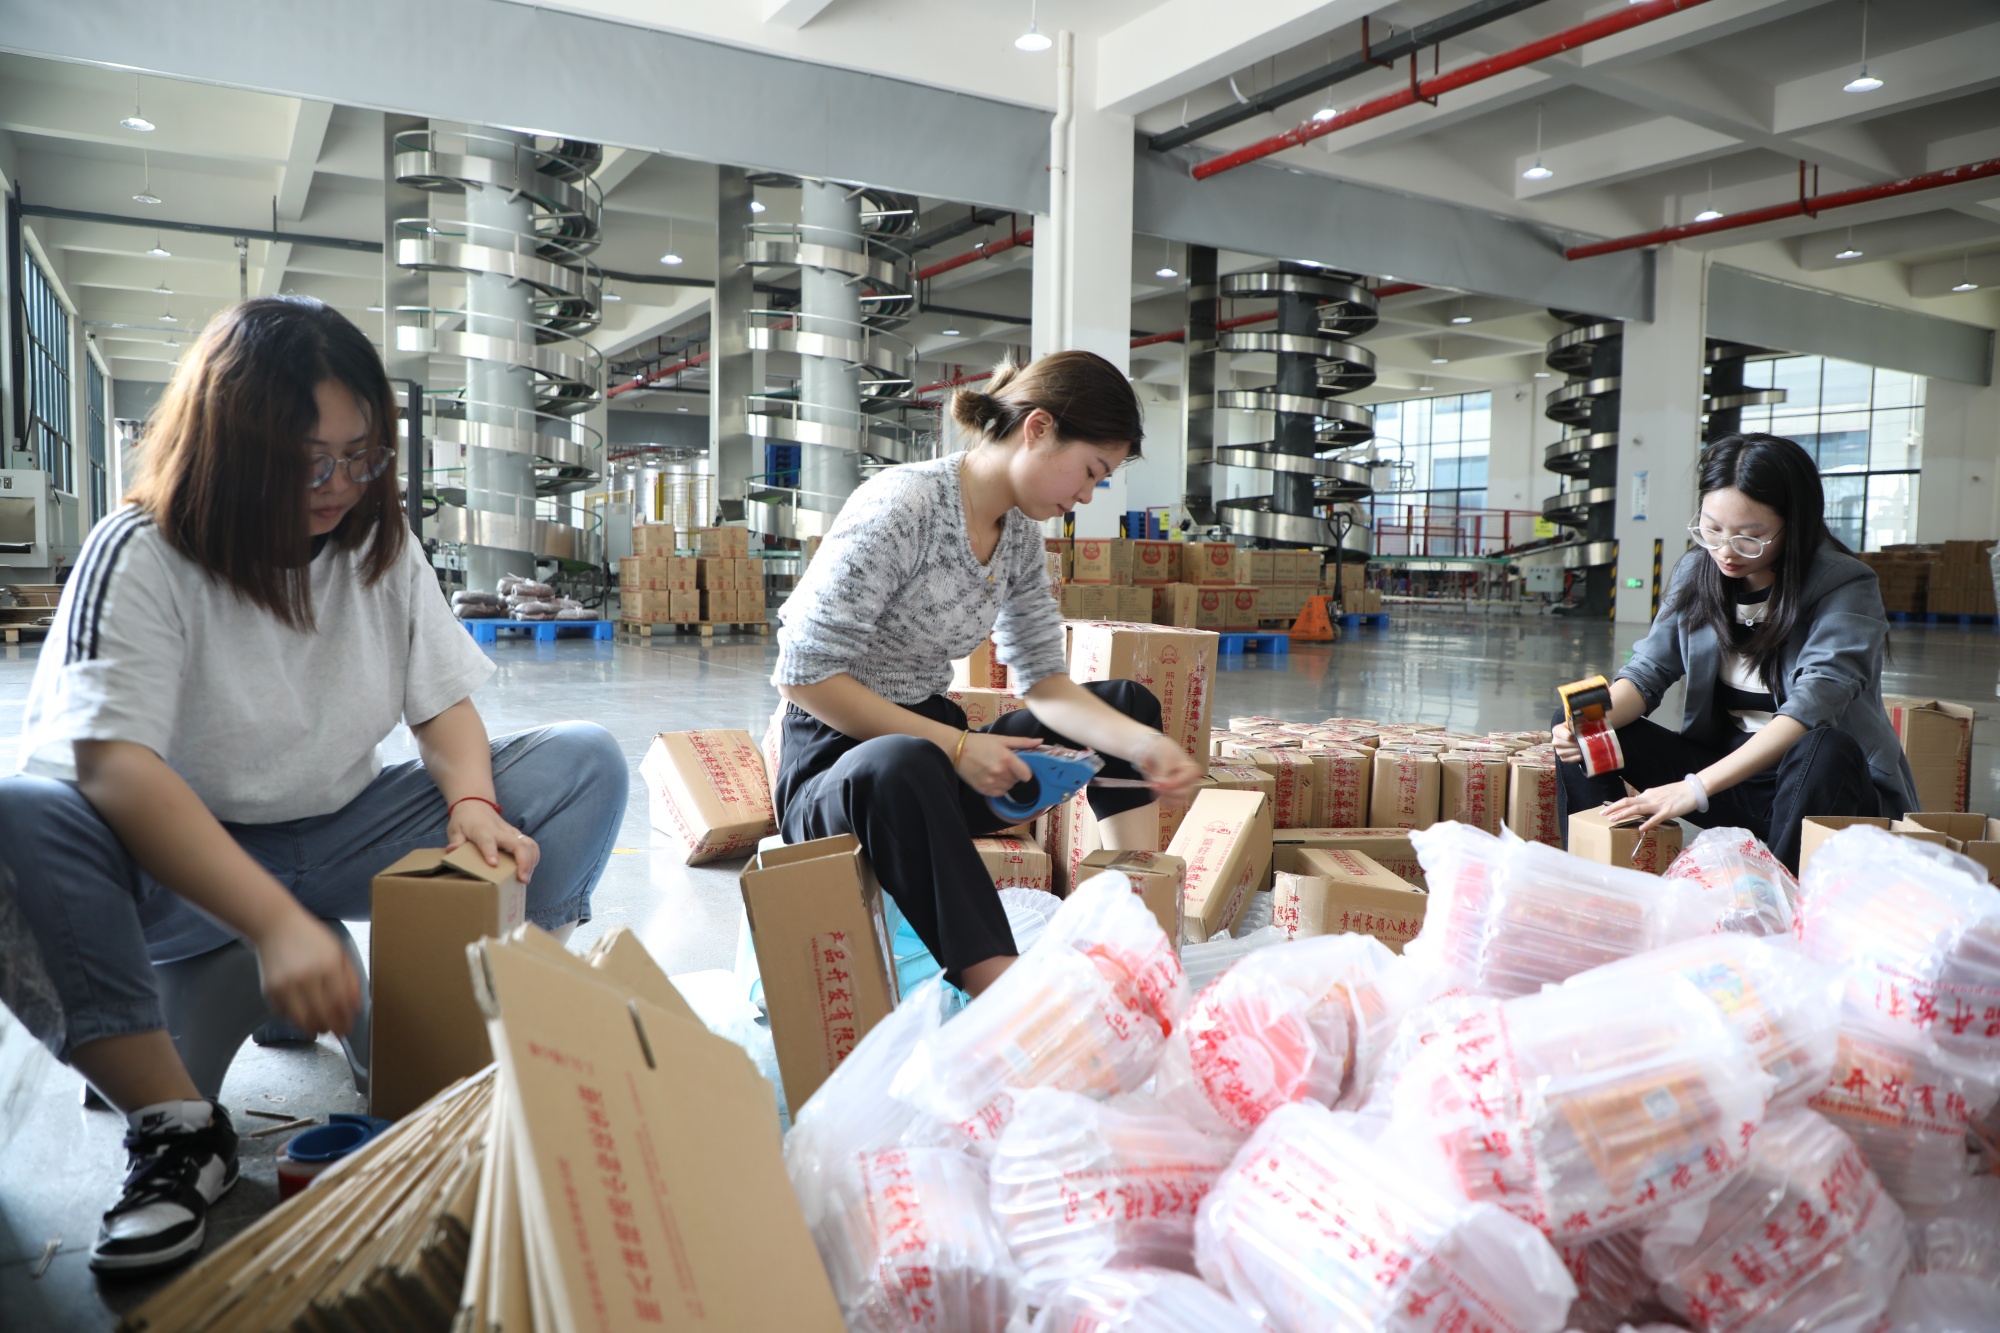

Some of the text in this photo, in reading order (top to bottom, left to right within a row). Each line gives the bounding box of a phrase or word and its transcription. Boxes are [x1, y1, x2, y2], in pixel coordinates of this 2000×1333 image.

[1339, 910, 1423, 938] 贵州长顺八妹农
[1829, 1067, 1979, 1124] 开发有限
